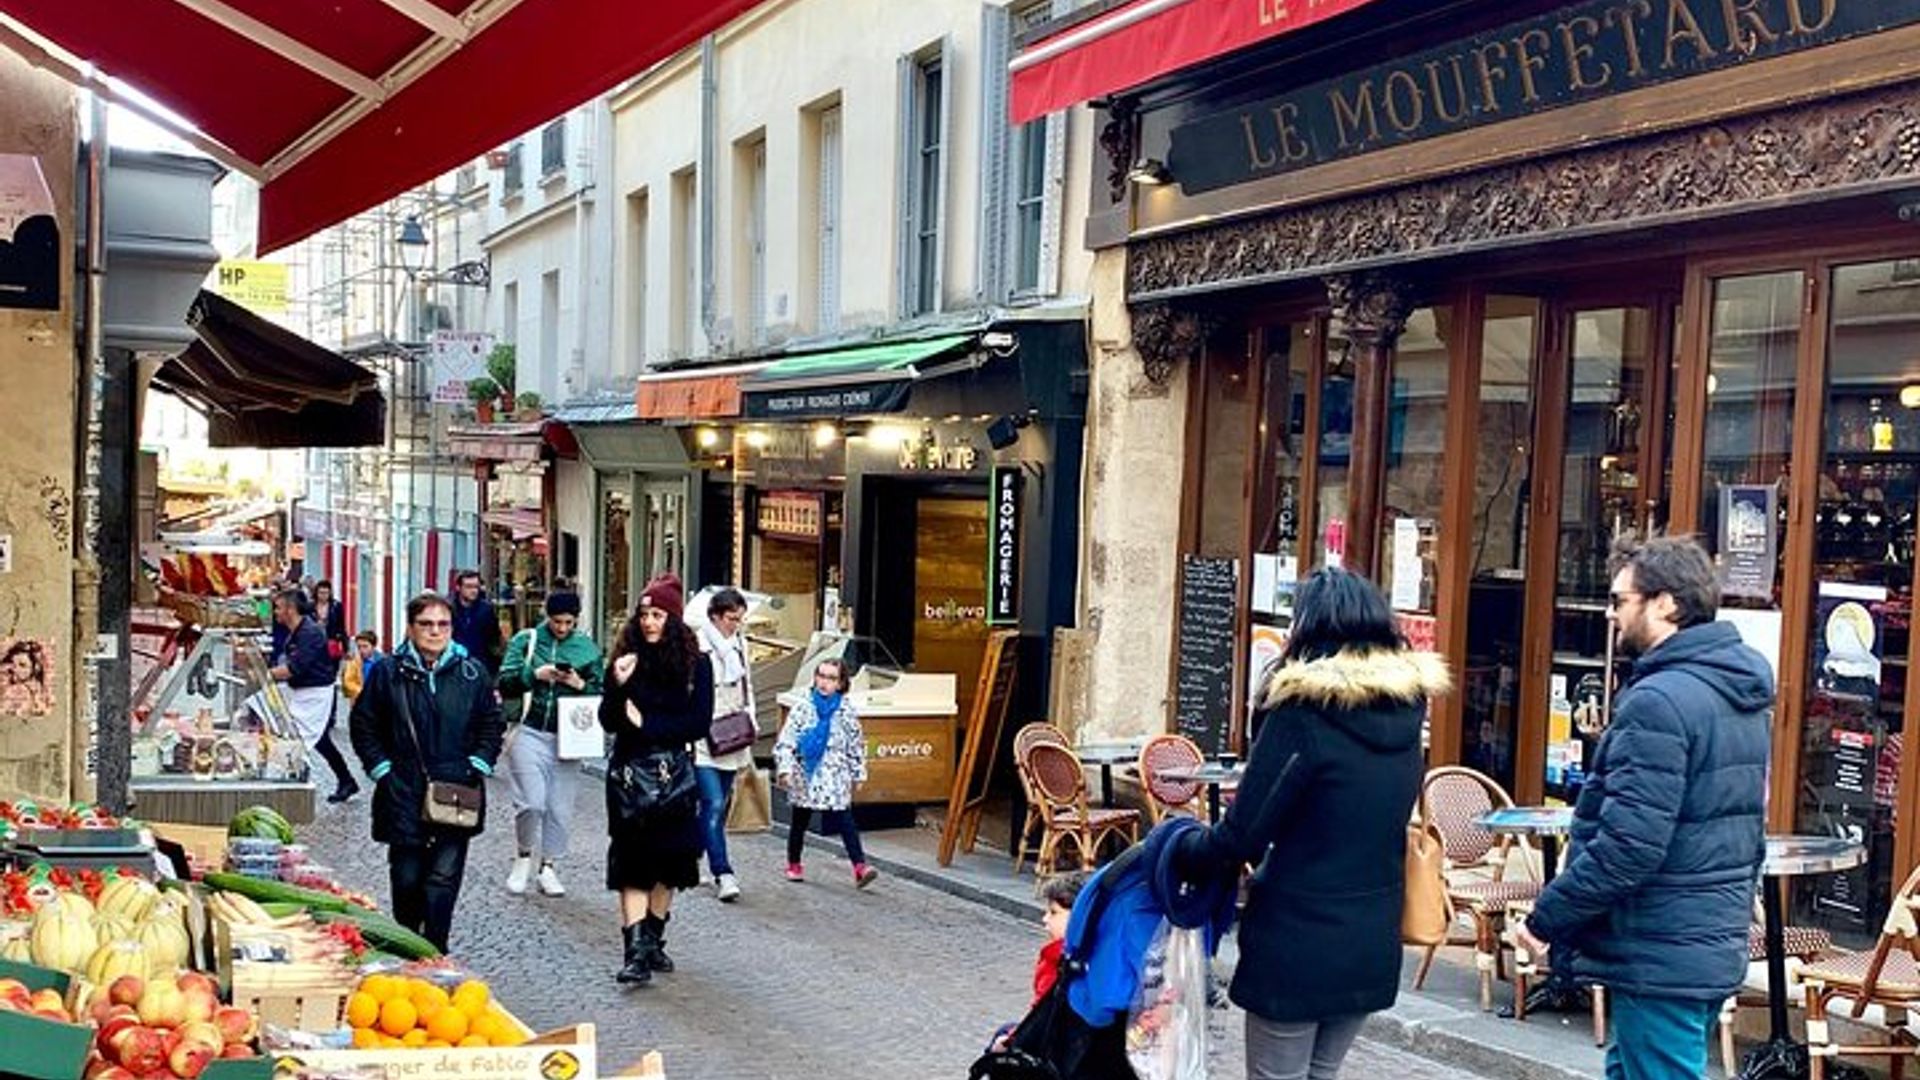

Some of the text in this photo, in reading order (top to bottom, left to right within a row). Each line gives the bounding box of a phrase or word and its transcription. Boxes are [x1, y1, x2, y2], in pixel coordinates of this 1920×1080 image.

[1258, 0, 1288, 26] LE
[1239, 102, 1309, 170] LE
[219, 268, 246, 285] HP
[999, 472, 1015, 614] FROMAGERIE
